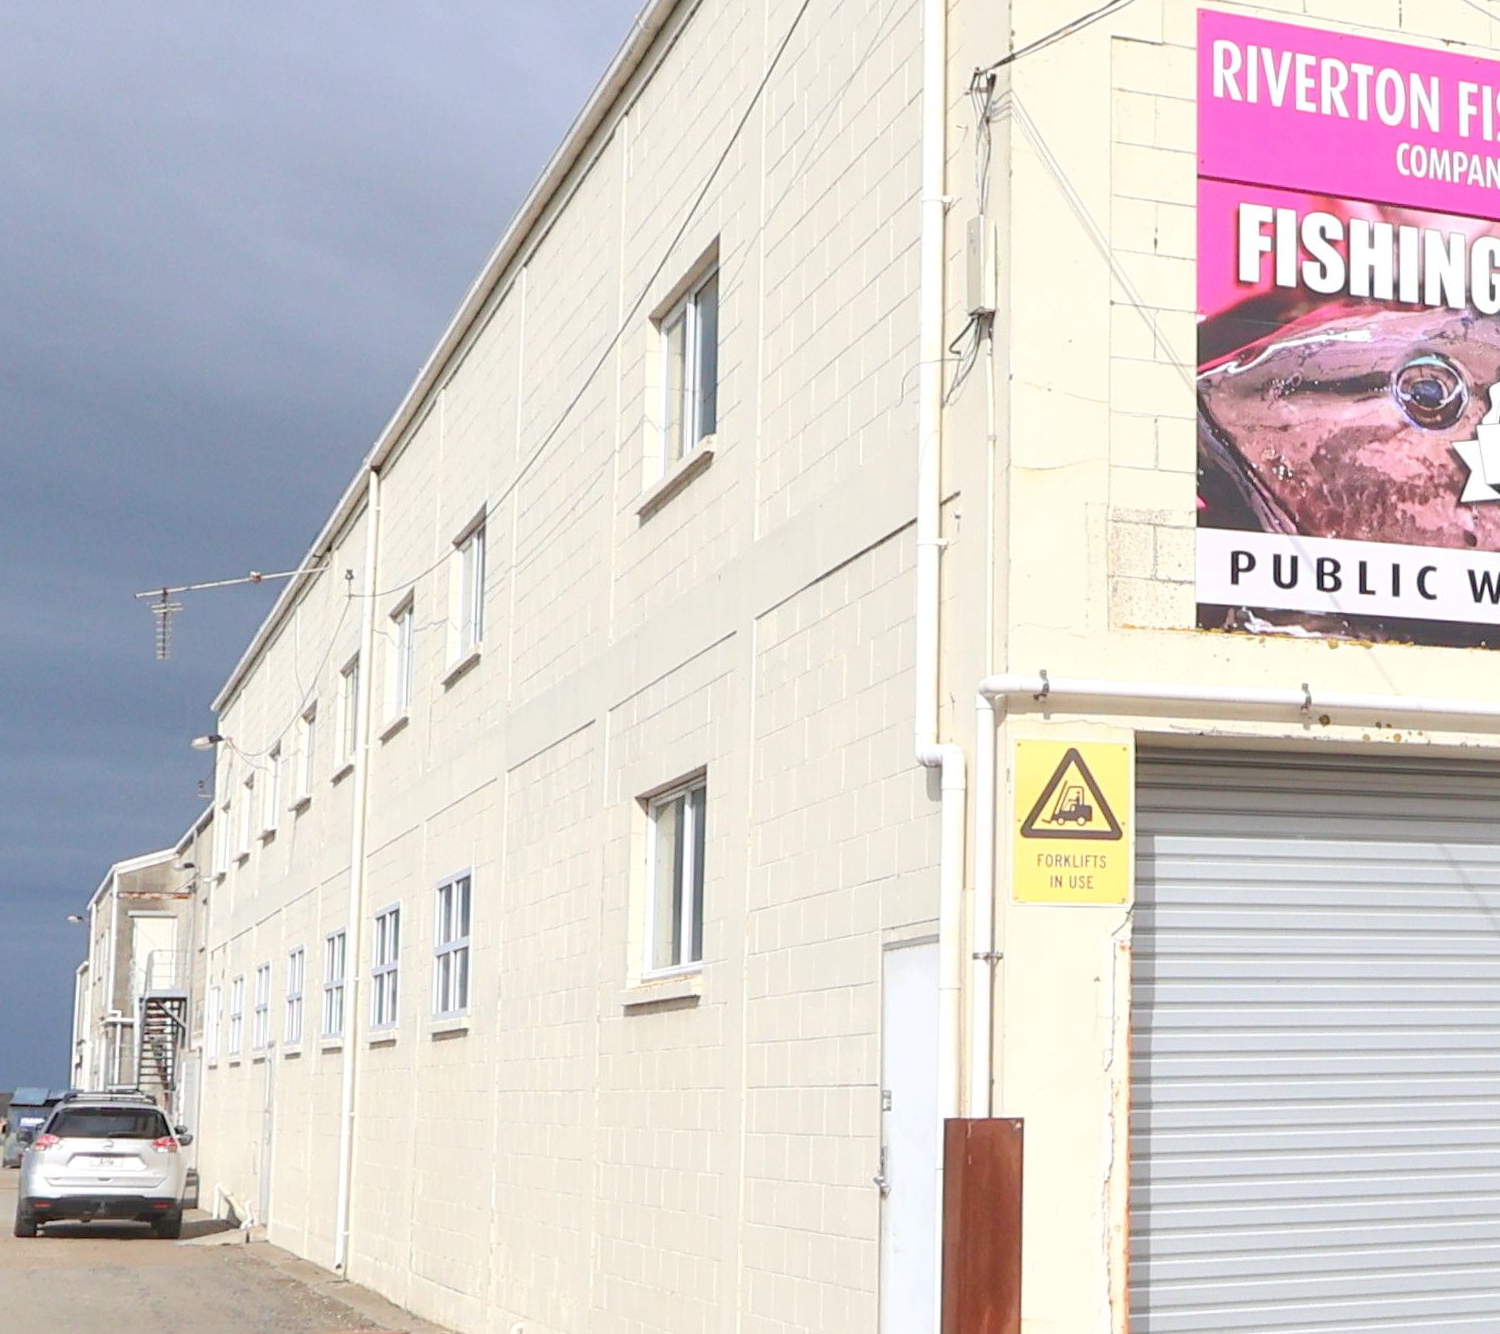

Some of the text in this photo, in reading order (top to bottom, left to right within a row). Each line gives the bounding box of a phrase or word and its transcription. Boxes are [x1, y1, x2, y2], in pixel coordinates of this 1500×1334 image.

[1212, 38, 1442, 136] RIVERTON
[1229, 549, 1439, 601] PUBLIC
[1036, 853, 1108, 869] FORKLIFTS
[1050, 875, 1094, 889] IN USE
